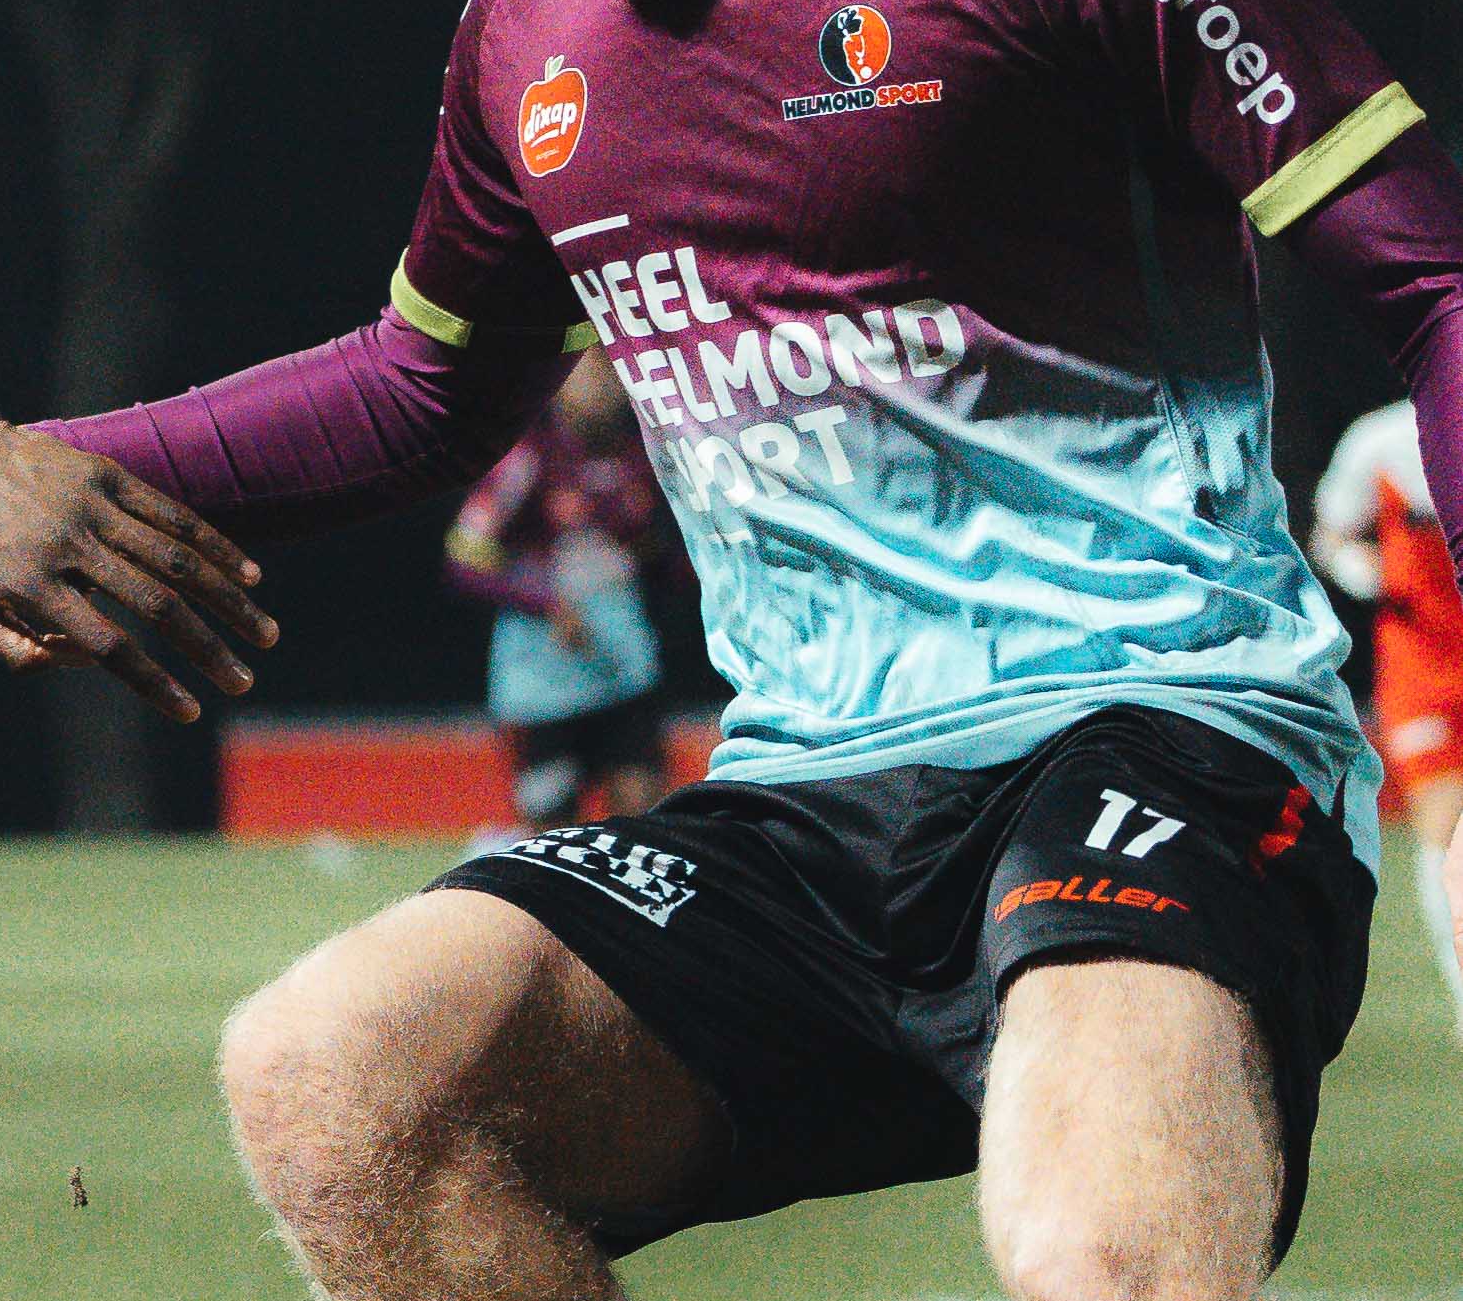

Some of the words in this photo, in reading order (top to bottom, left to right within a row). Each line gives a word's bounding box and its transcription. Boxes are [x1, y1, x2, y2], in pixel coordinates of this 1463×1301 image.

[783, 89, 875, 120] HELMOND
[876, 81, 942, 107] SPORT
[612, 300, 966, 428] HELMOND
[1084, 788, 1187, 858] 17
